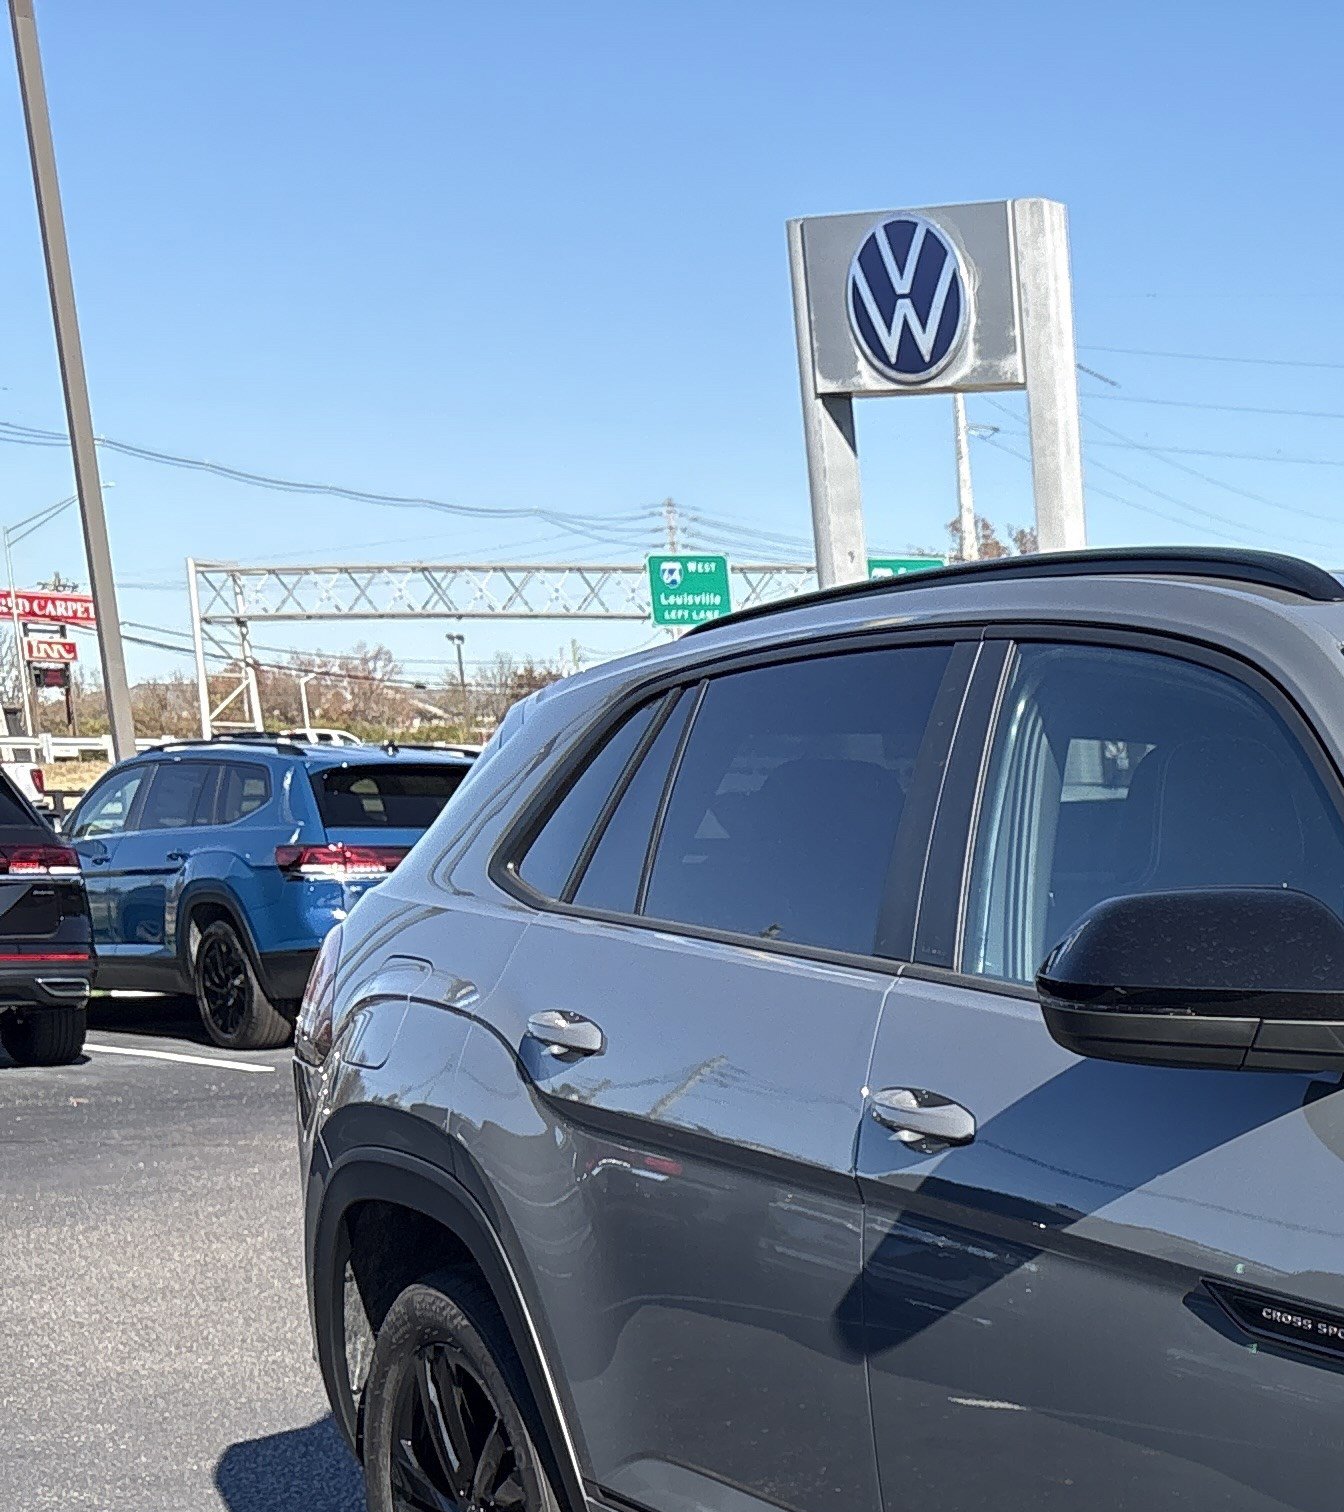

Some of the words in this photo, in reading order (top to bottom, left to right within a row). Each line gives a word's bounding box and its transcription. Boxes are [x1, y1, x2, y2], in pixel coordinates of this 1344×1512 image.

[686, 561, 717, 574] WEST
[660, 592, 721, 606] Louisville
[32, 599, 96, 619] CARPET
[1262, 1308, 1312, 1330] CROSS
